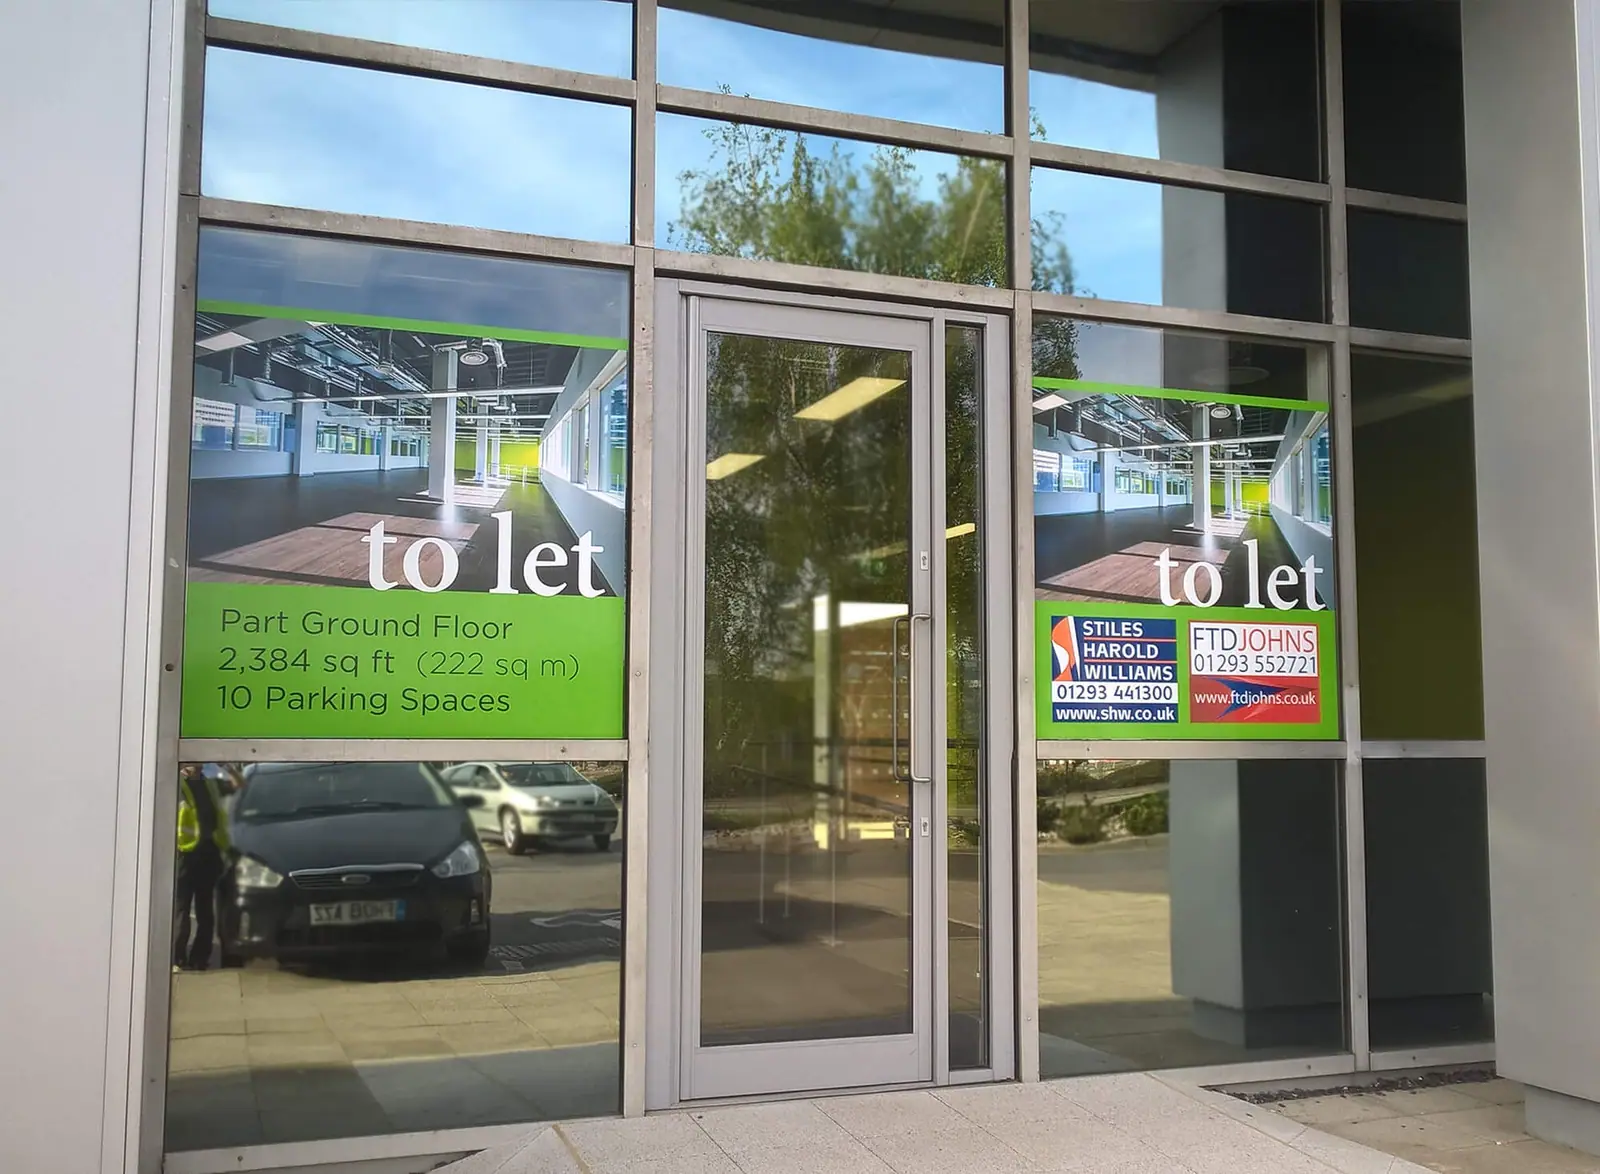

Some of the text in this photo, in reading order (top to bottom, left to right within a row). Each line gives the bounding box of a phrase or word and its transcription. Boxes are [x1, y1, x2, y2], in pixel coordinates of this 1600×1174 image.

[361, 510, 606, 599] to let
[1154, 538, 1326, 611] to let
[221, 608, 513, 639] Part Ground Floor
[1082, 620, 1144, 637] STILES
[1083, 642, 1159, 659] HAROLD
[218, 646, 580, 680] 2,384 sq ft (222 sq m)
[1194, 654, 1316, 674] 01293 552721
[1084, 665, 1173, 681] WILLIAMS
[217, 685, 510, 715] 10 Parking Spaces
[1056, 684, 1173, 700] 01293 441300
[1194, 690, 1316, 708] www.ftdjohns.co.uk
[1056, 706, 1175, 721] www.shw.co.uk
